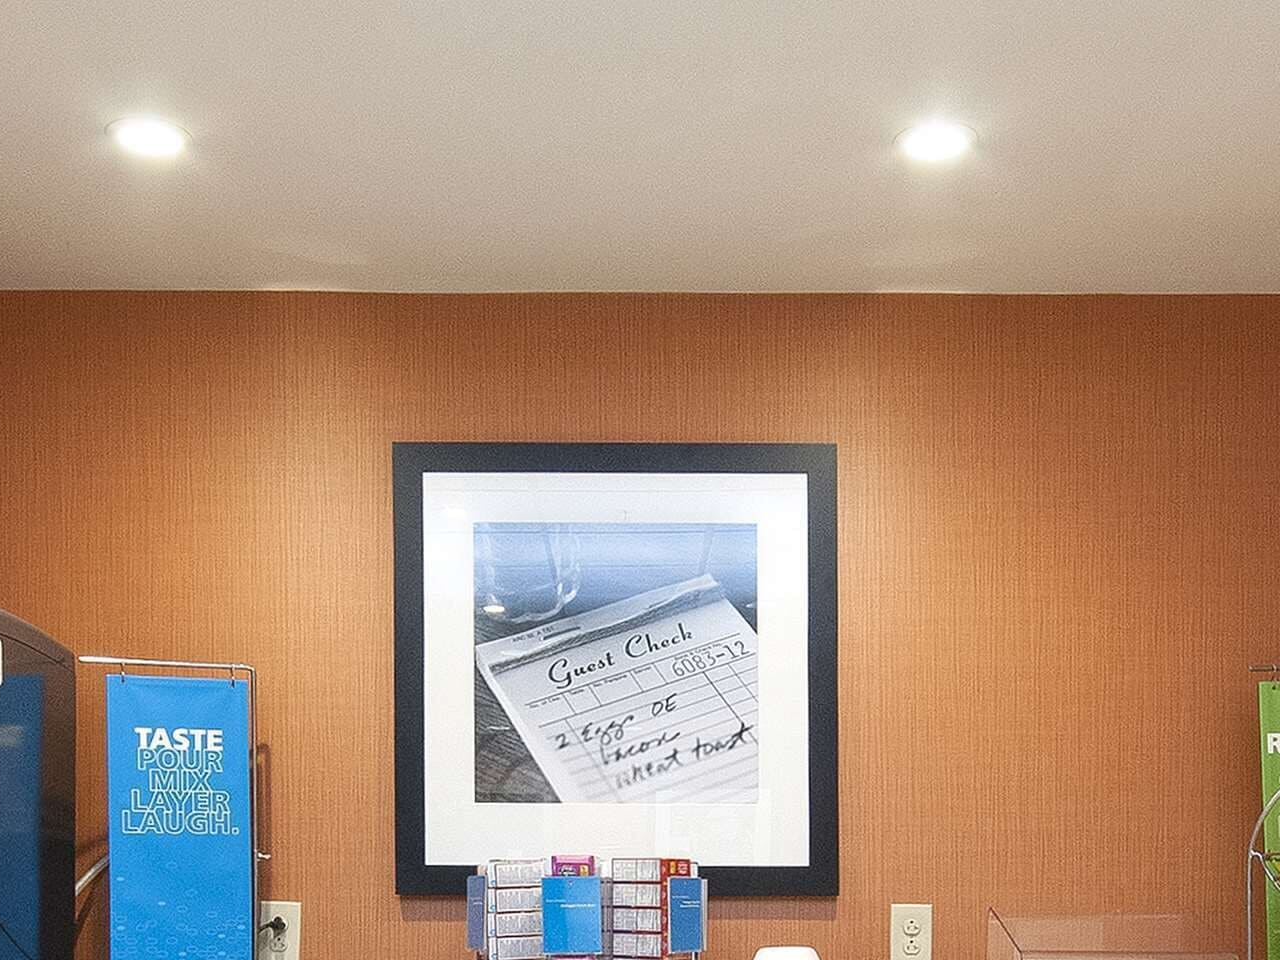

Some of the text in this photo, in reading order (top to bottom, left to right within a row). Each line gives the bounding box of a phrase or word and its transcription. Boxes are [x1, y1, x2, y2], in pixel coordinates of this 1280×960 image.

[548, 652, 616, 689] Guest
[624, 622, 694, 659] Check
[672, 640, 750, 676] 6083-12
[134, 727, 224, 752] TASTE
[555, 733, 569, 750] 2
[137, 746, 224, 773] POUR
[149, 768, 213, 793] MIX
[131, 788, 231, 815] LAYER
[122, 809, 240, 835] LAUGH.
